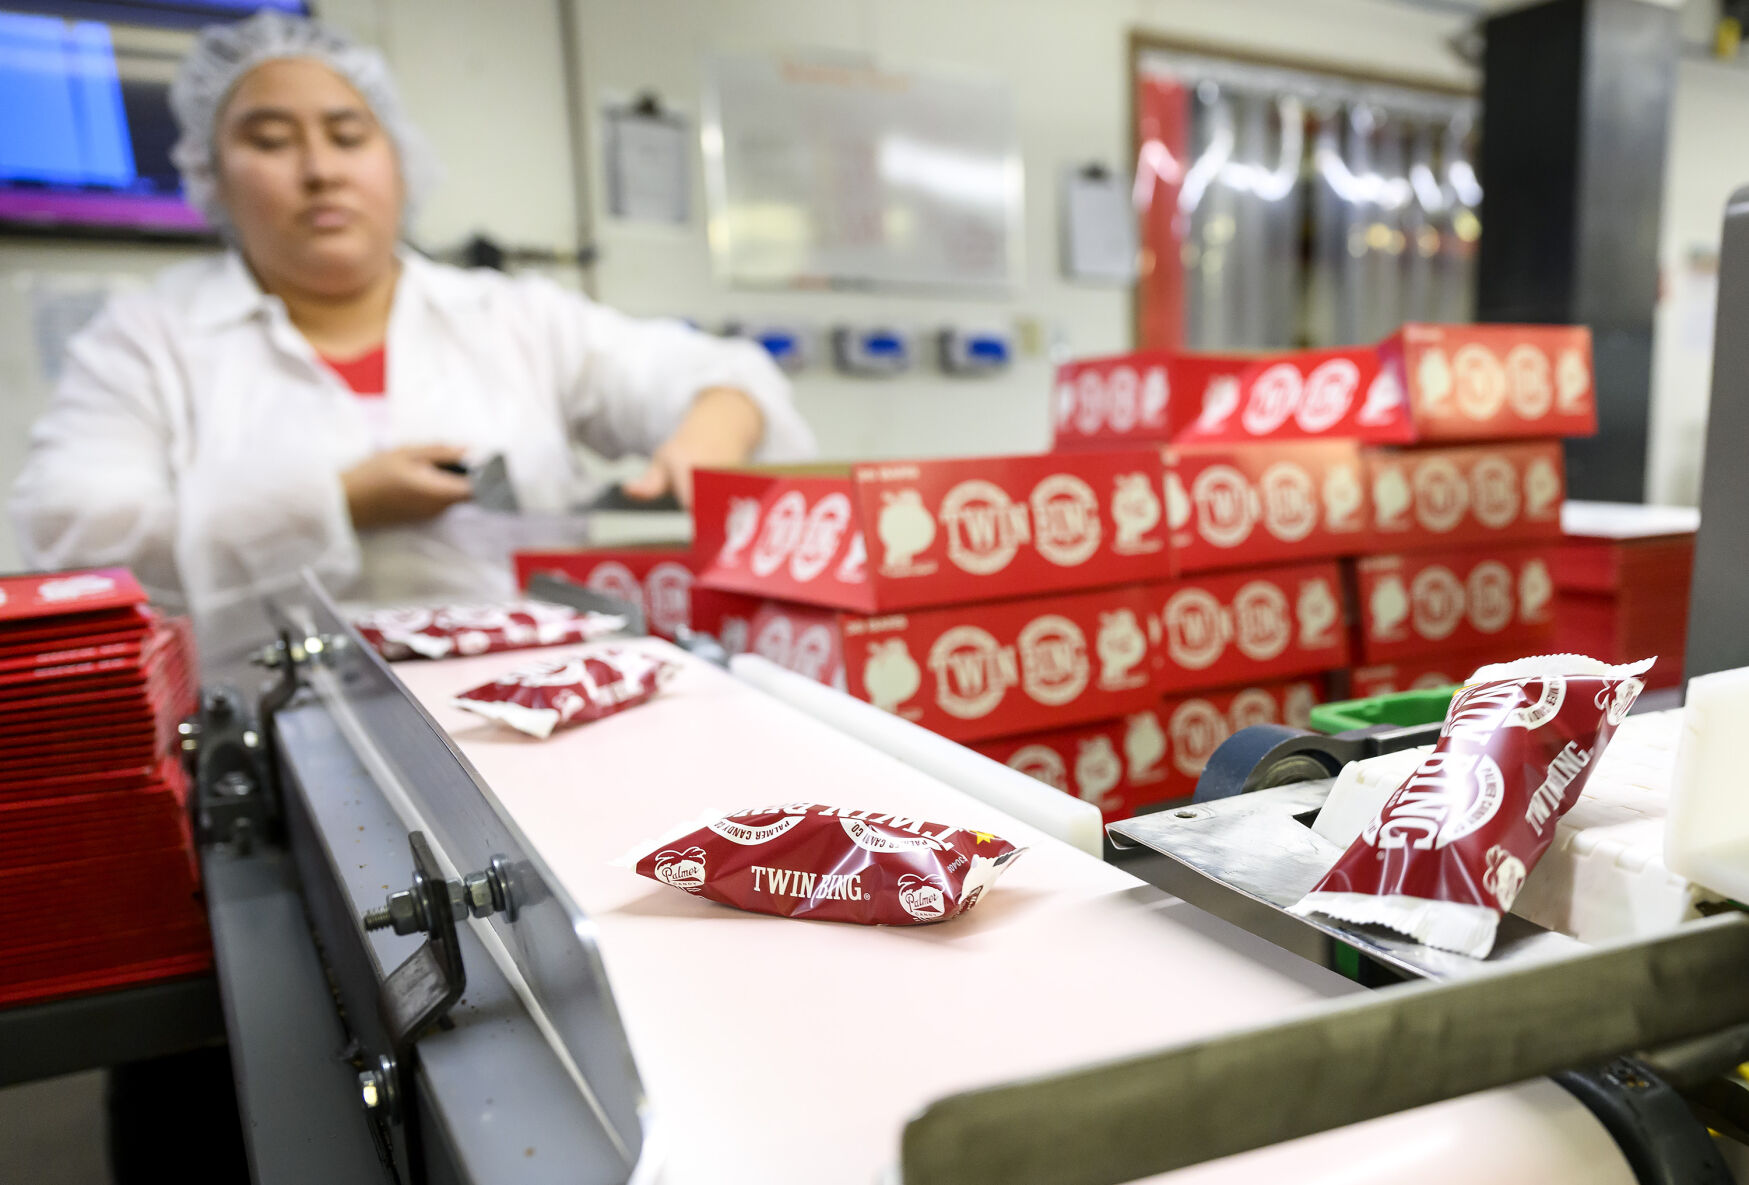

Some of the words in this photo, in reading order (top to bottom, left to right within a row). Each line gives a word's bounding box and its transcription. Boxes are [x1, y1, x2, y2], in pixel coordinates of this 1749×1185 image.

[723, 825, 752, 840] CANDY
[755, 820, 790, 840] PALMER
[662, 866, 700, 883] Palmer
[751, 865, 817, 899] TWIN
[904, 893, 938, 913] Palmer
